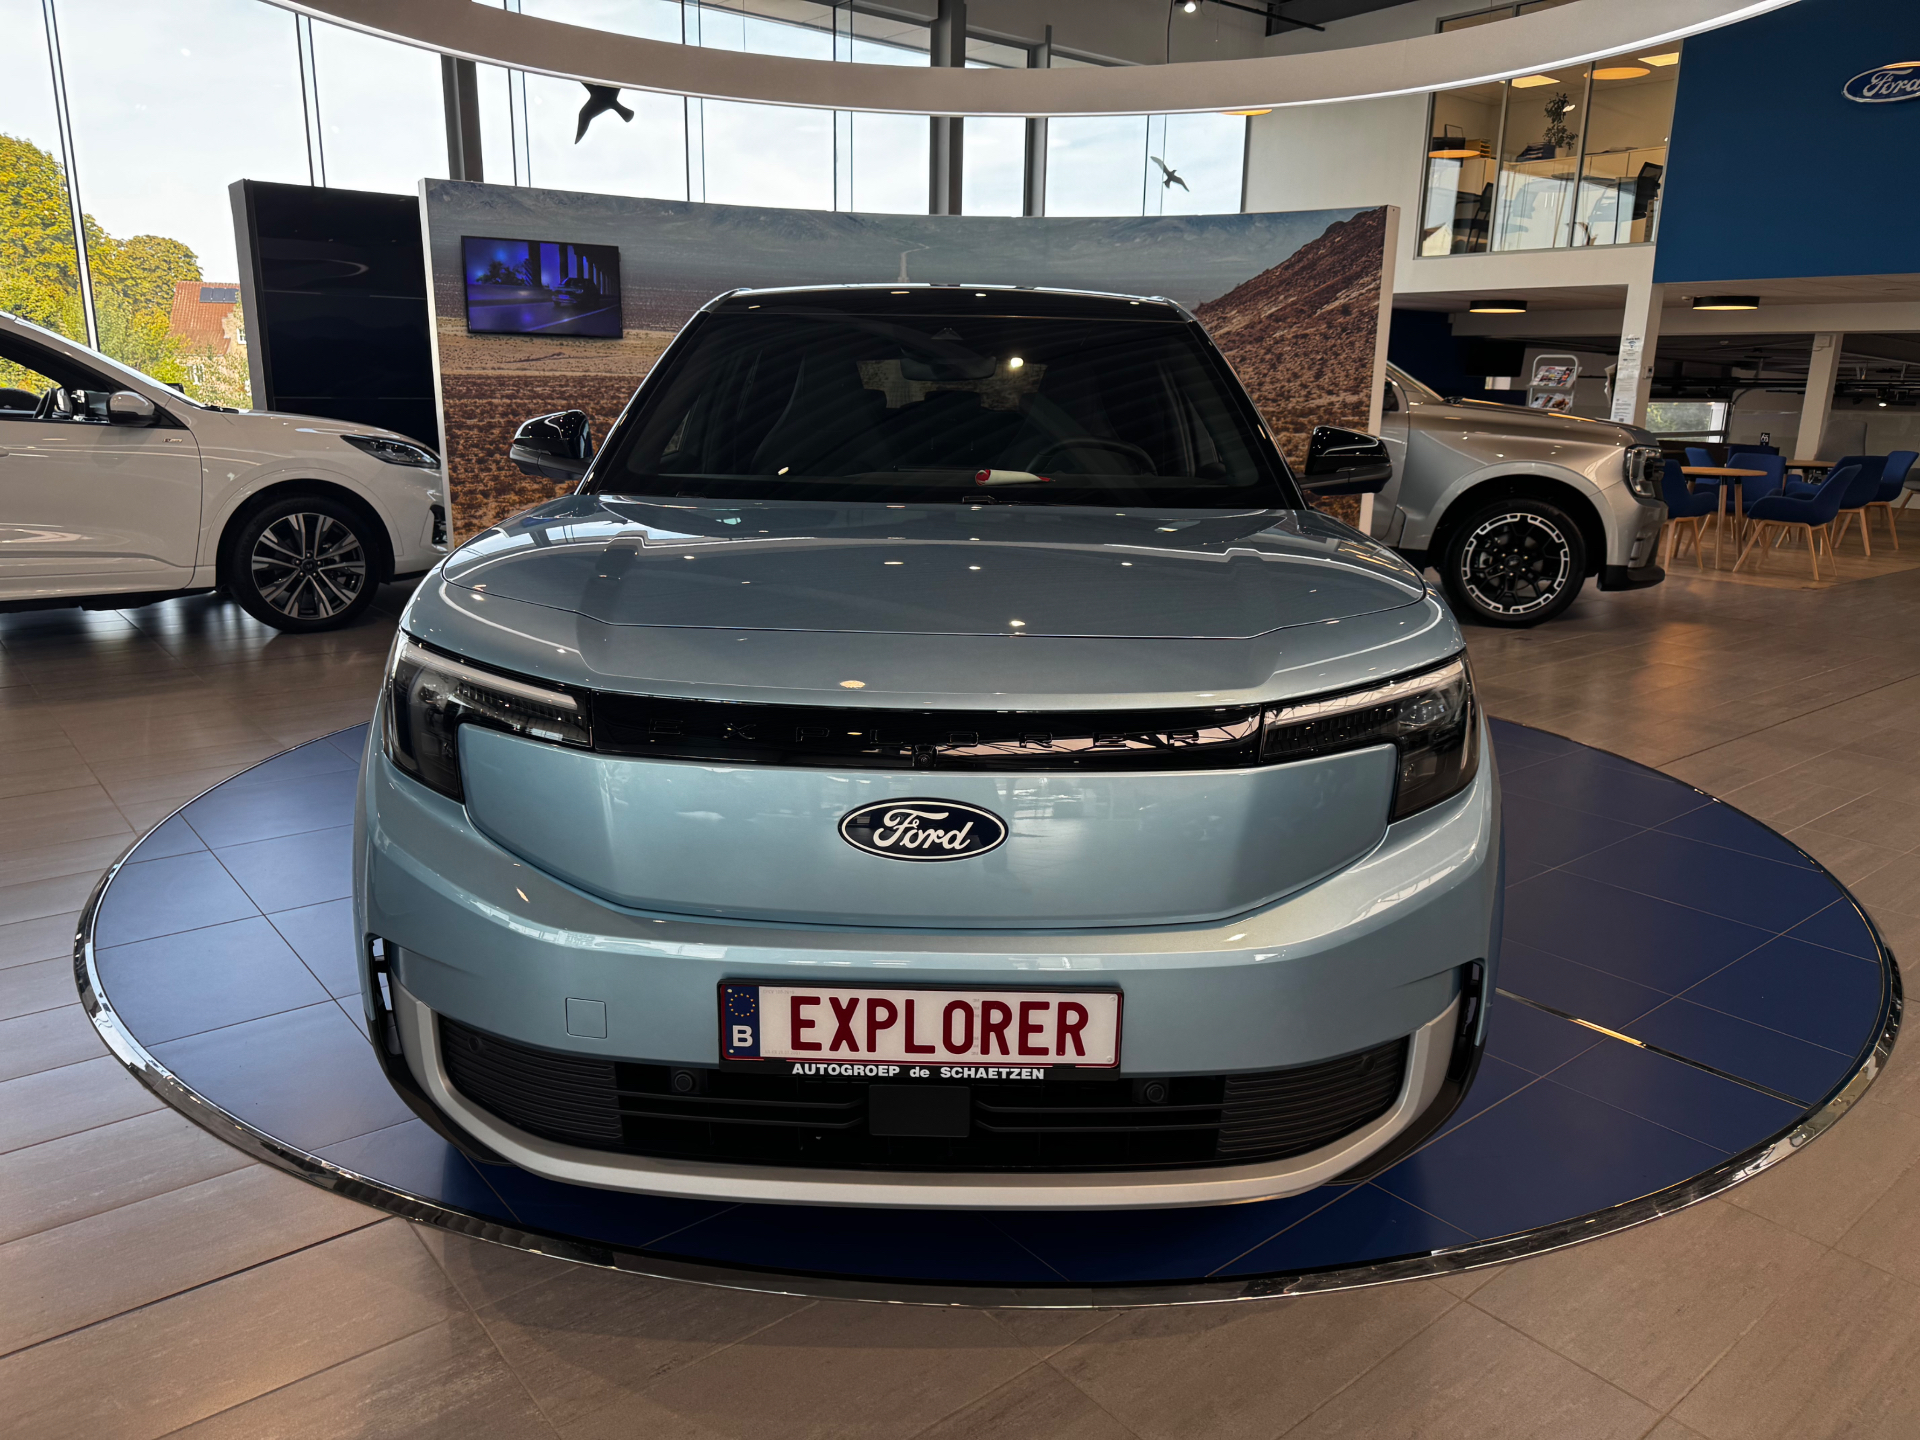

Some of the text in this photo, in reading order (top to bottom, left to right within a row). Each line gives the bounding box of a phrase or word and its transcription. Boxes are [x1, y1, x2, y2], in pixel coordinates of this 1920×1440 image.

[649, 718, 1199, 748] EXPLORER
[873, 808, 974, 850] Ford
[732, 1024, 753, 1048] B
[790, 995, 1089, 1057] EXPLORER
[792, 1063, 1045, 1080] AUTOGROEP de SCHAETZEN
